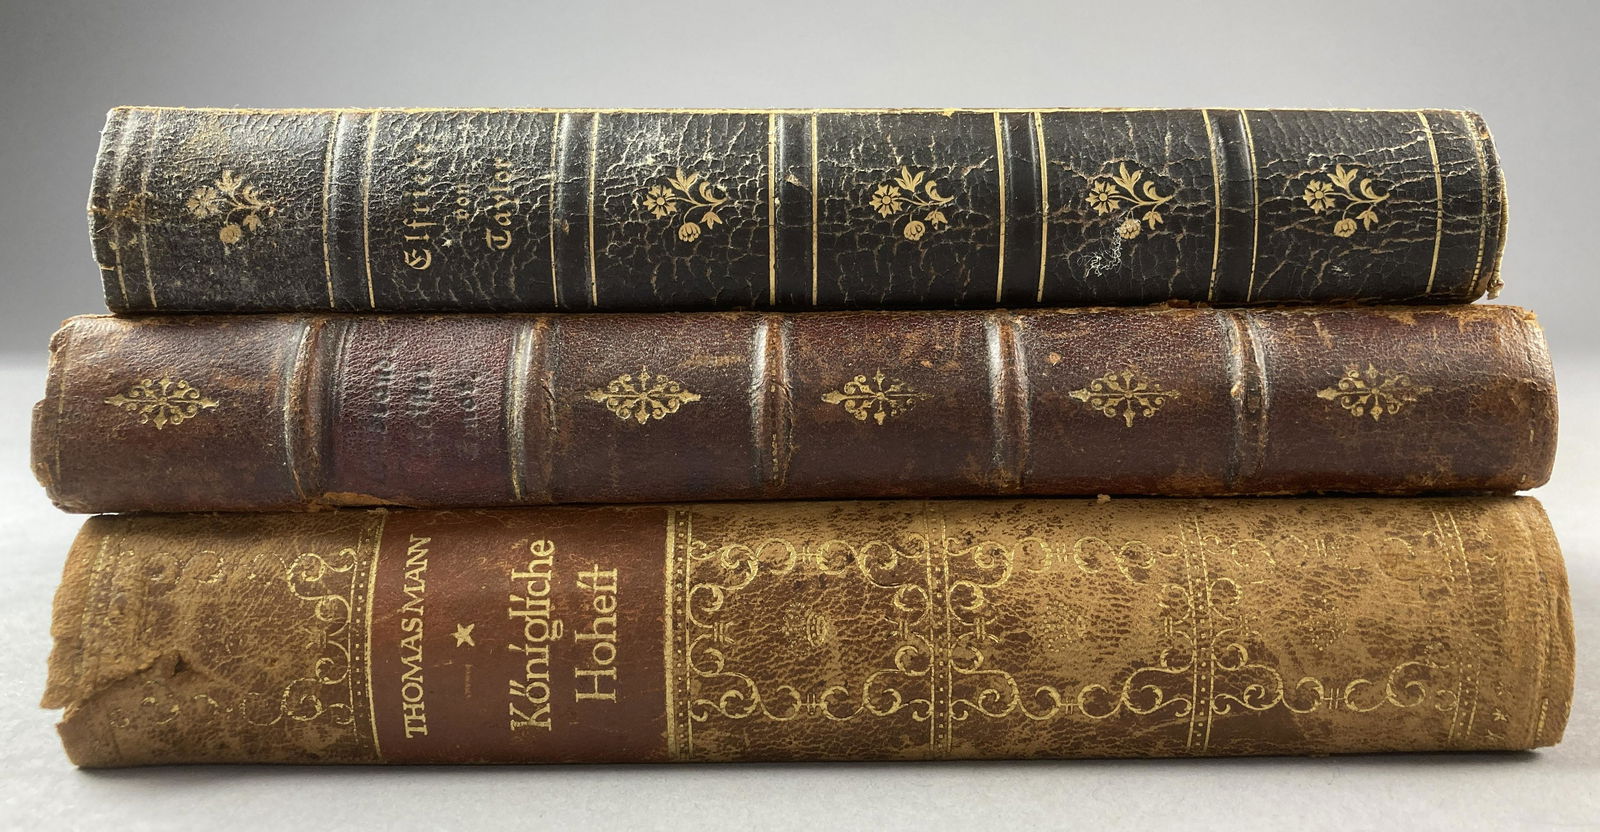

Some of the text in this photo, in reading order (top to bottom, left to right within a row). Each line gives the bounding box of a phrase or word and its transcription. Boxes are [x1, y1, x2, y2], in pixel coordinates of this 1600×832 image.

[485, 156, 520, 251] Taylor
[508, 538, 564, 732] Königliche
[574, 563, 618, 704] Hoheit
